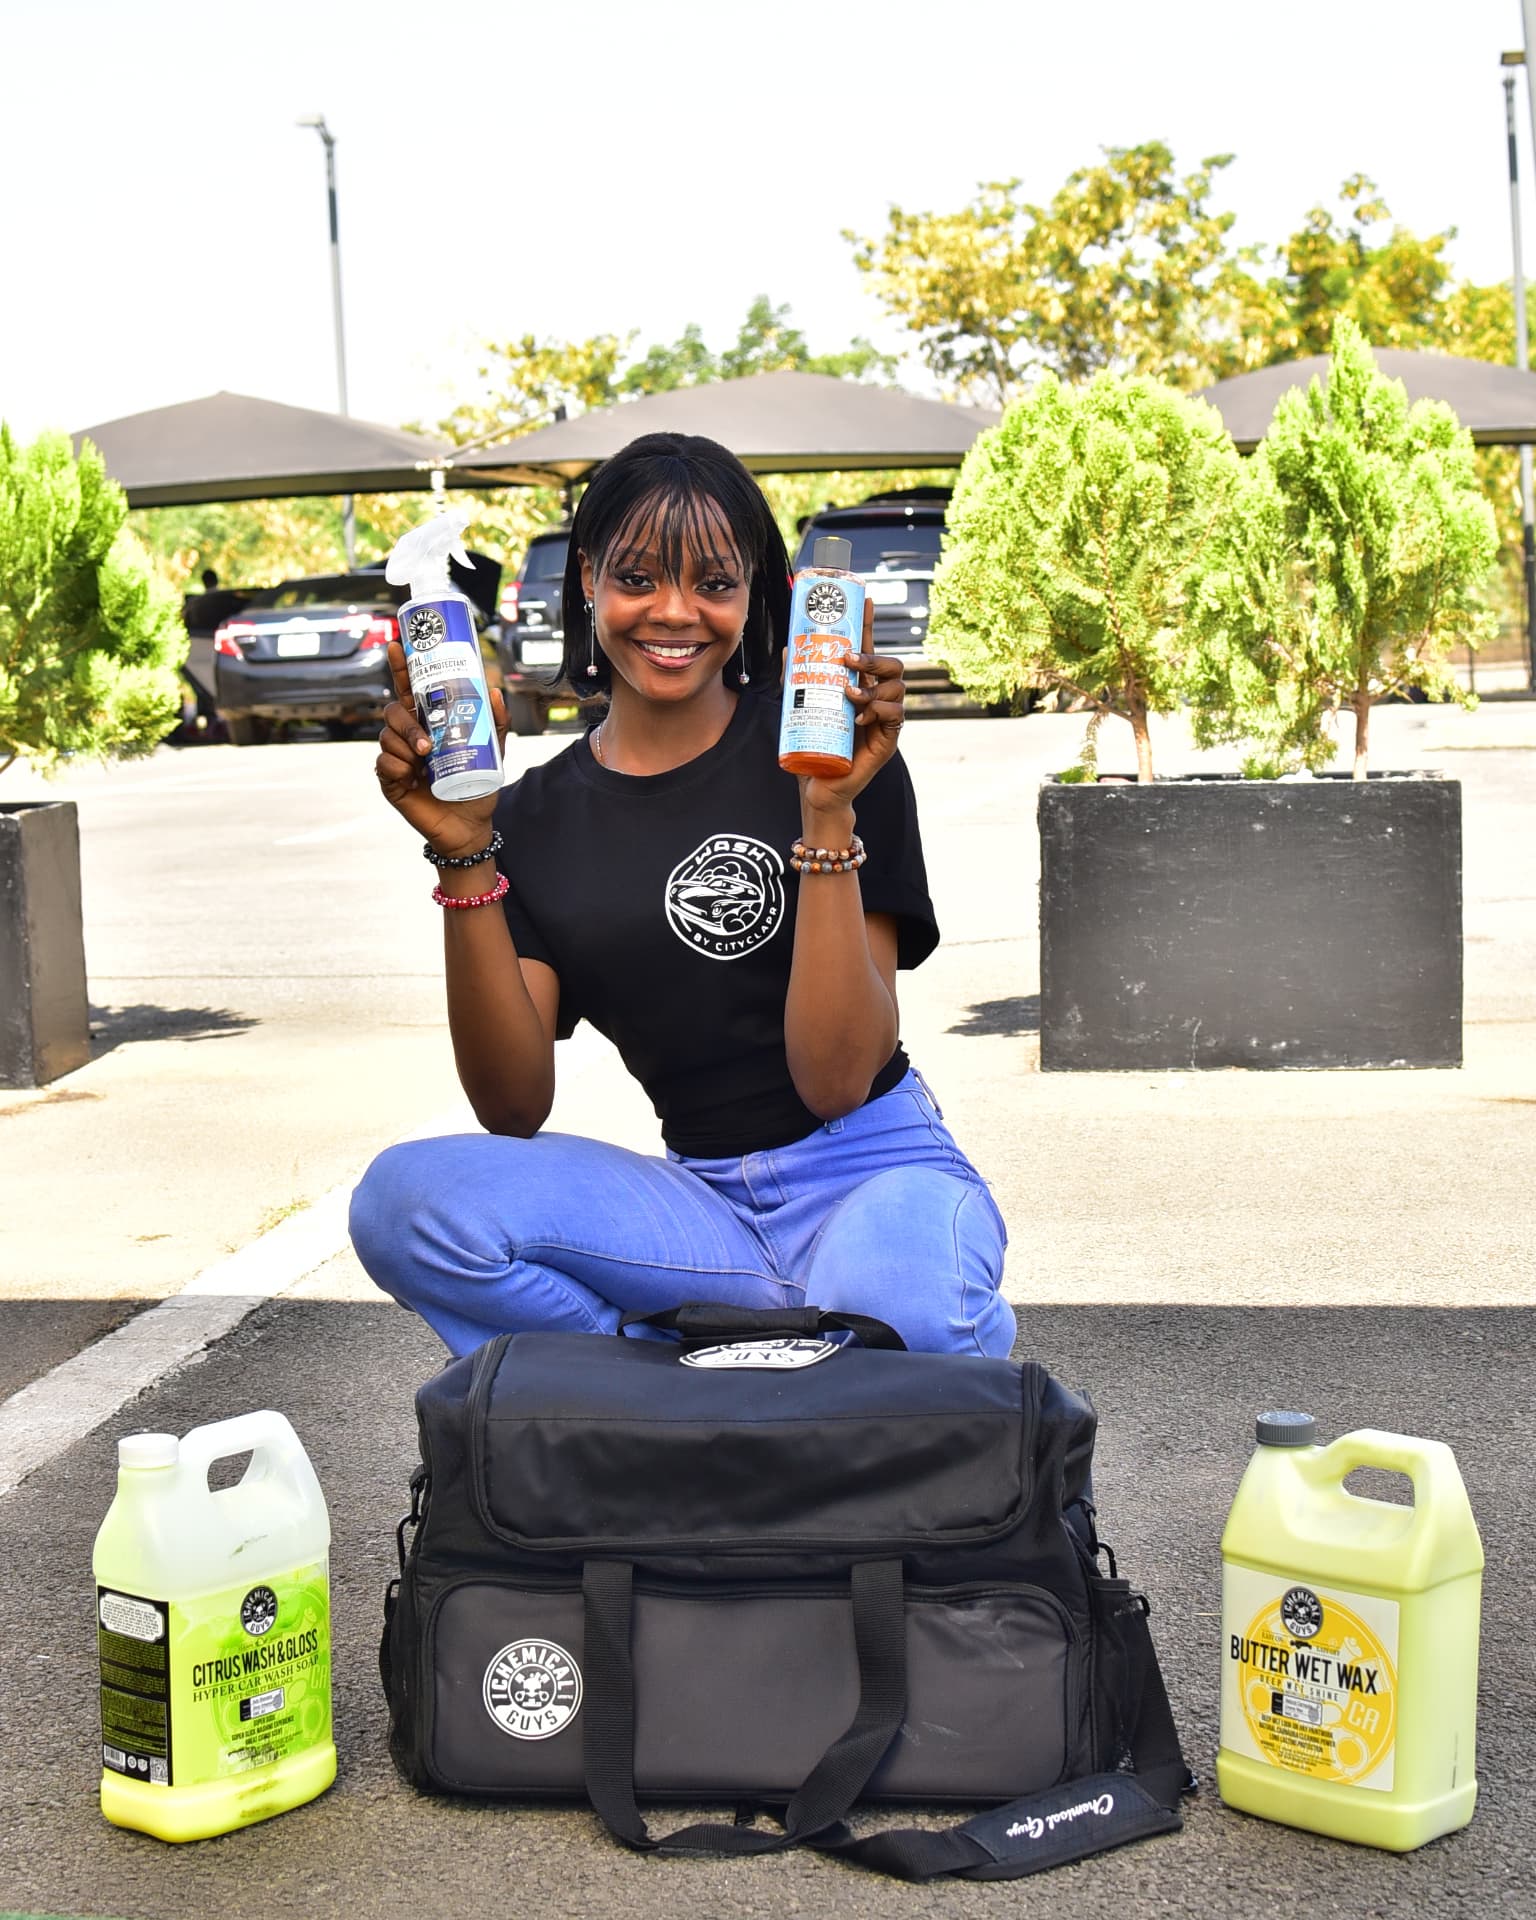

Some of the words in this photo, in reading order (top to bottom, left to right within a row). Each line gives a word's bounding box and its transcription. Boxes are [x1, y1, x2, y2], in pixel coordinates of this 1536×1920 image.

[808, 586, 845, 605] CHEMICAL
[813, 613, 837, 622] GUYS
[416, 636, 438, 649] GUYS
[695, 840, 766, 865] WASH
[693, 932, 710, 946] BY
[715, 906, 778, 952] CITYCLAPR
[243, 1589, 276, 1617] CHEMICAL
[1284, 1591, 1320, 1617] CHEMICAL
[250, 1620, 270, 1633] GUYS
[1289, 1621, 1313, 1635] GUYS
[193, 1654, 240, 1687] CITRUS
[491, 1646, 575, 1691] CHEMICAL
[1230, 1634, 1290, 1676] BUTTER
[1295, 1652, 1332, 1685] WET
[1337, 1662, 1378, 1695] WAX
[193, 1686, 234, 1702] HYPER
[238, 1676, 261, 1691] CAR
[264, 1666, 294, 1682] WASH
[296, 1654, 319, 1673] SOAP
[1260, 1674, 1282, 1688] DEEP
[1286, 1681, 1305, 1693] WET
[1310, 1687, 1339, 1702] SHINE
[506, 1709, 558, 1731] GUYS
[1045, 1793, 1114, 1830] Chemical
[1006, 1816, 1044, 1839] Guys
